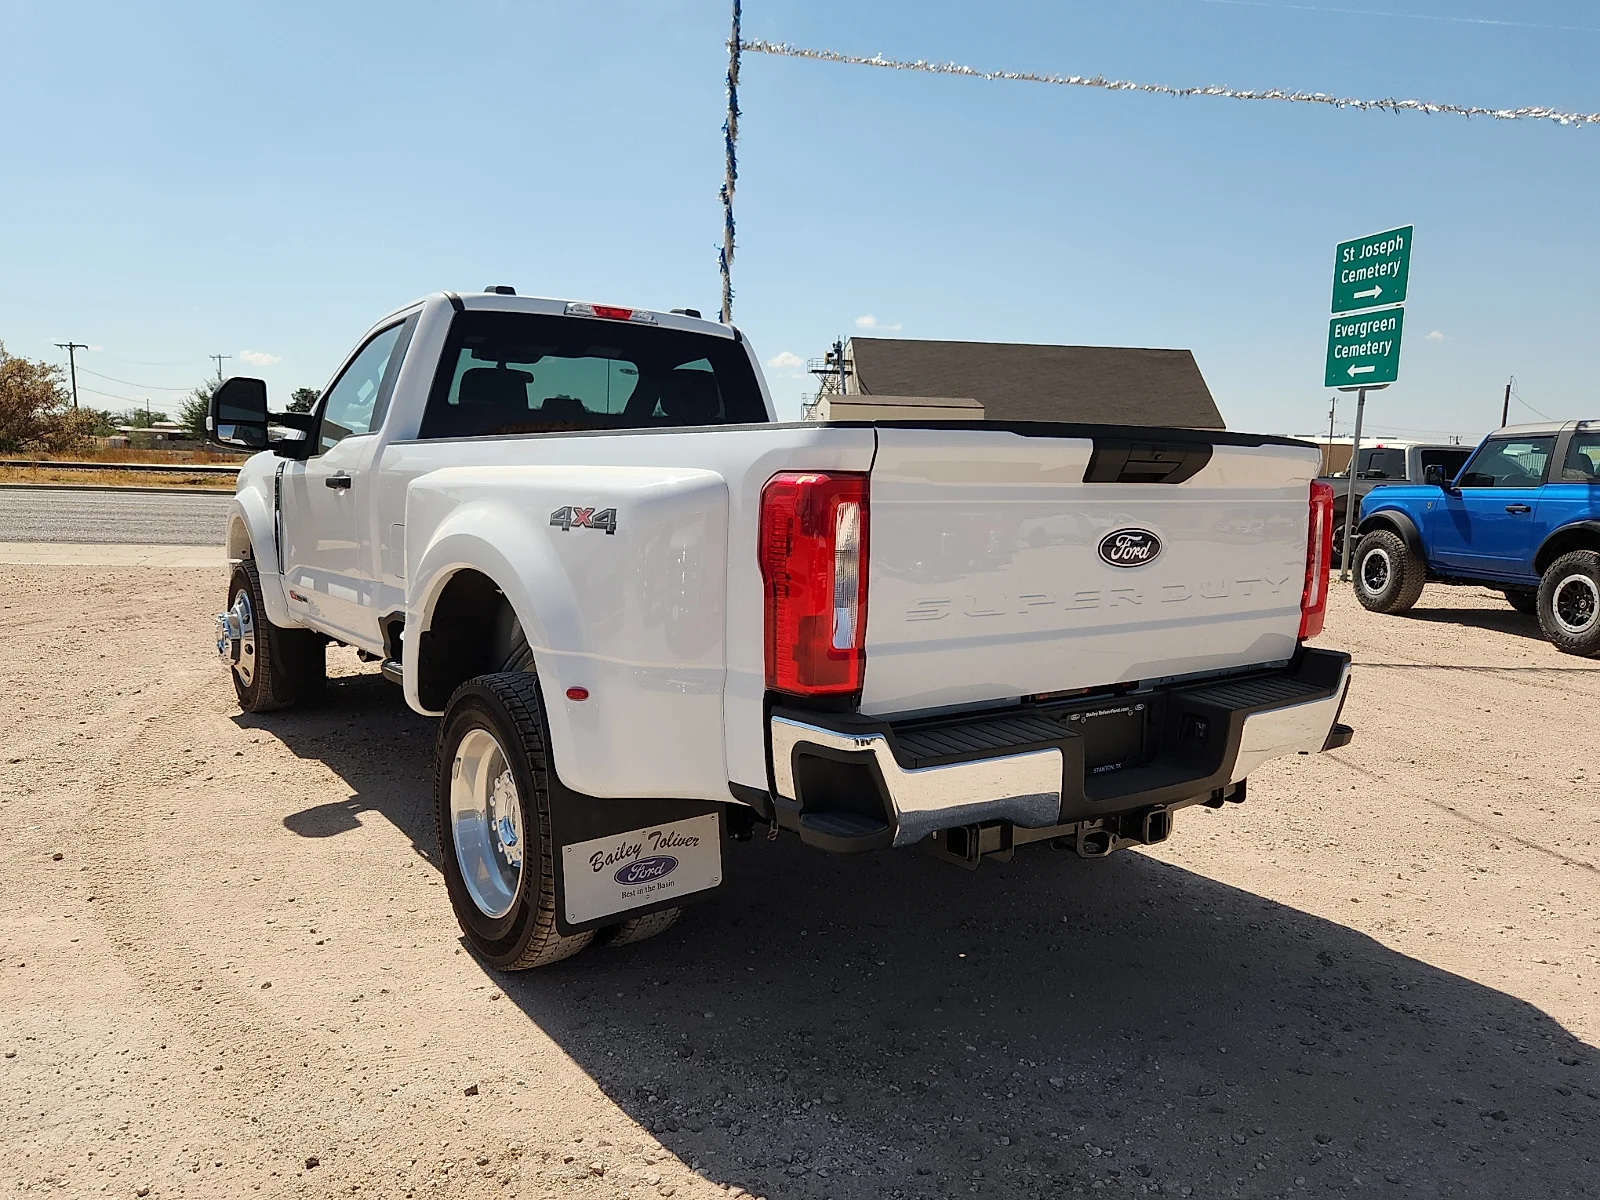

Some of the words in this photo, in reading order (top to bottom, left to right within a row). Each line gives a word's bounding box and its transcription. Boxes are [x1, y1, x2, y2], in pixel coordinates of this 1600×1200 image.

[1342, 248, 1355, 262] St
[1359, 235, 1404, 259] Joseph
[1341, 259, 1400, 284] Cemetery
[1334, 317, 1396, 338] Evergreen
[1334, 339, 1392, 359] Cemetery
[1110, 534, 1152, 560] Ford
[906, 587, 1143, 622] SUPER
[1160, 576, 1290, 603] DUTY
[589, 841, 643, 873] Bailey
[648, 830, 700, 851] Toliver
[627, 860, 666, 882] Ford
[621, 891, 636, 899] Best
[645, 884, 656, 893] the
[657, 880, 675, 891] Basin
